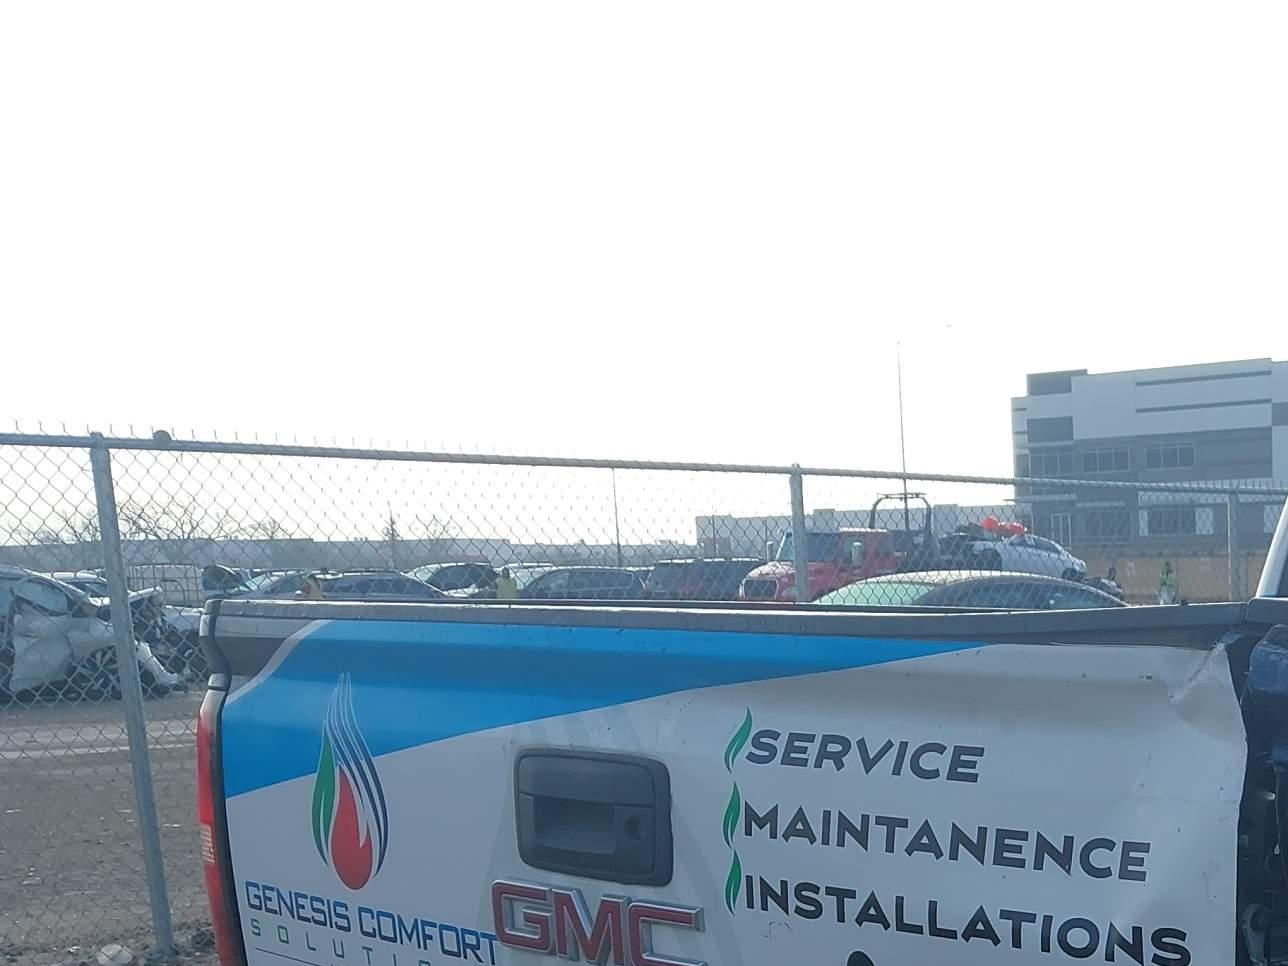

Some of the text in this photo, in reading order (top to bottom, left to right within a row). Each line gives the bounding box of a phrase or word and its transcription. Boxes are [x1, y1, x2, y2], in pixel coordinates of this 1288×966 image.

[746, 728, 985, 783] SERVICE
[744, 800, 1151, 882] MAINTANENCE
[245, 880, 500, 965] GENESIS COMFORT
